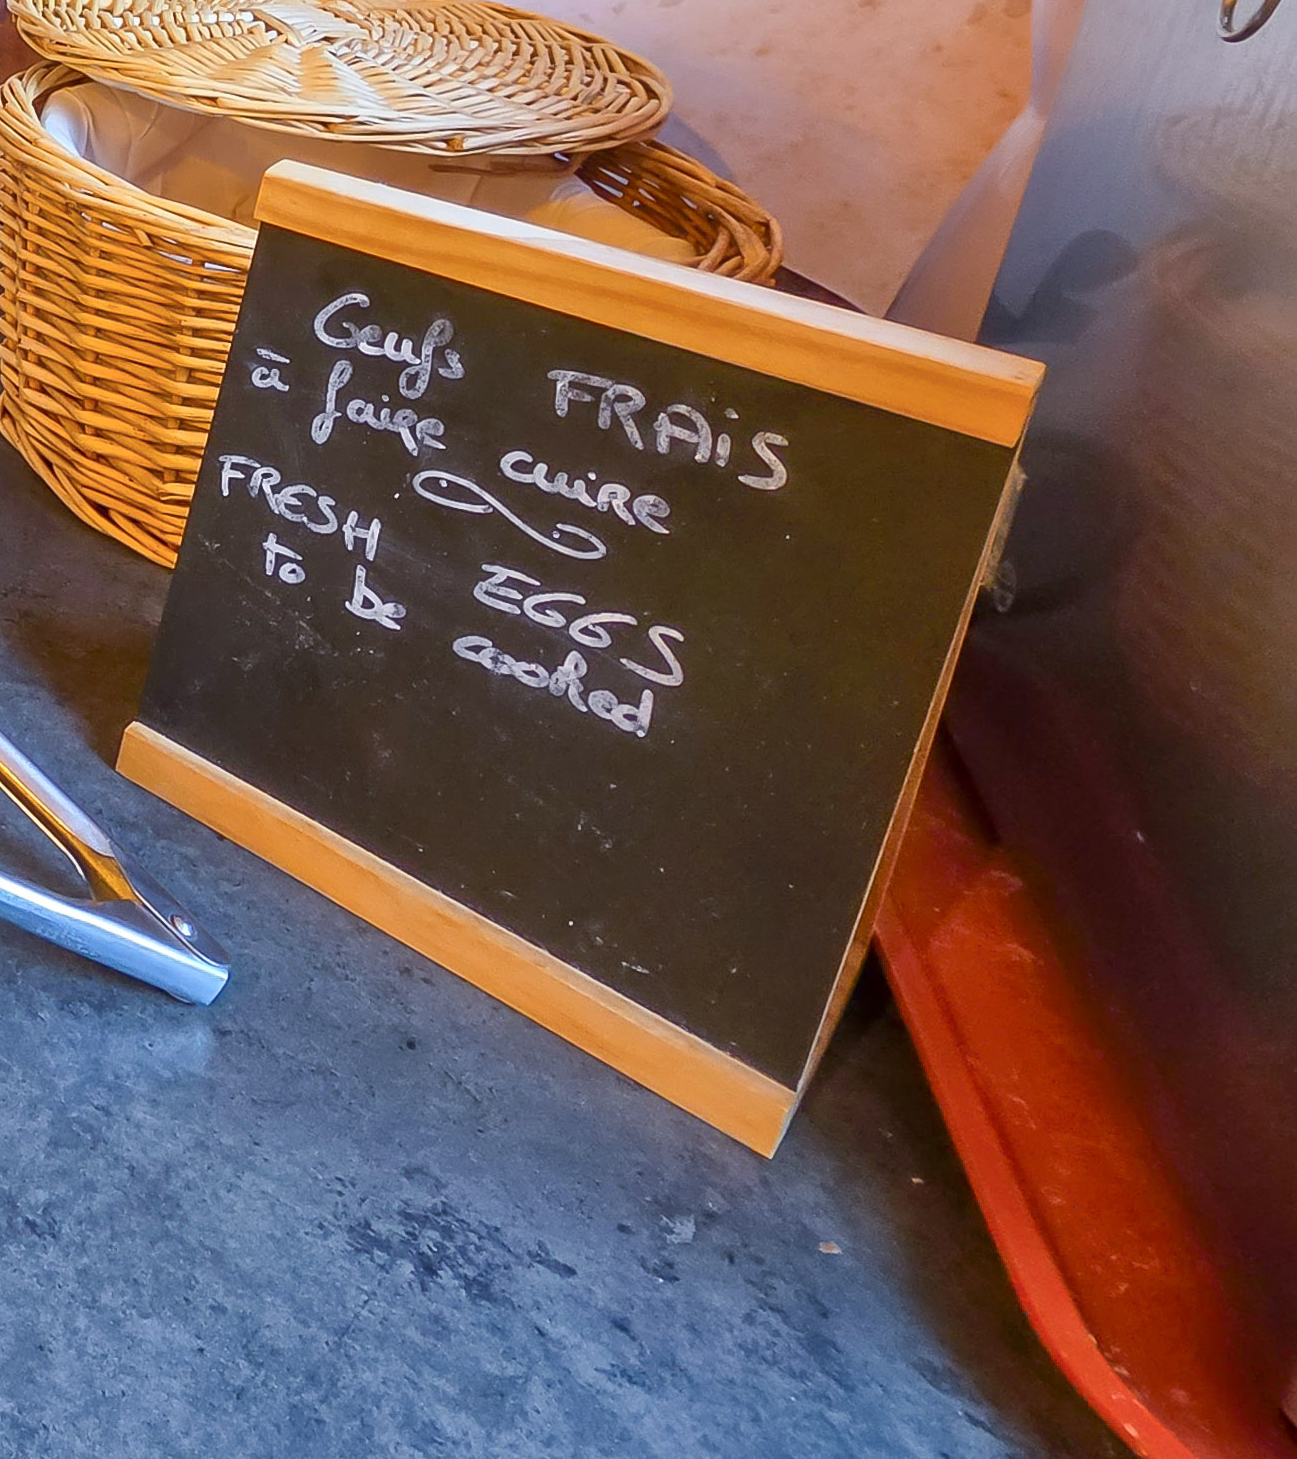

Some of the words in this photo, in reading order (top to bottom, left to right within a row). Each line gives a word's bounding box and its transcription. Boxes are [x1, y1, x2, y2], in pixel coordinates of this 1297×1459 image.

[218, 454, 382, 563] FRESH
[472, 563, 685, 688] EGGS
[344, 564, 407, 631] be
[451, 634, 655, 739] cooked
